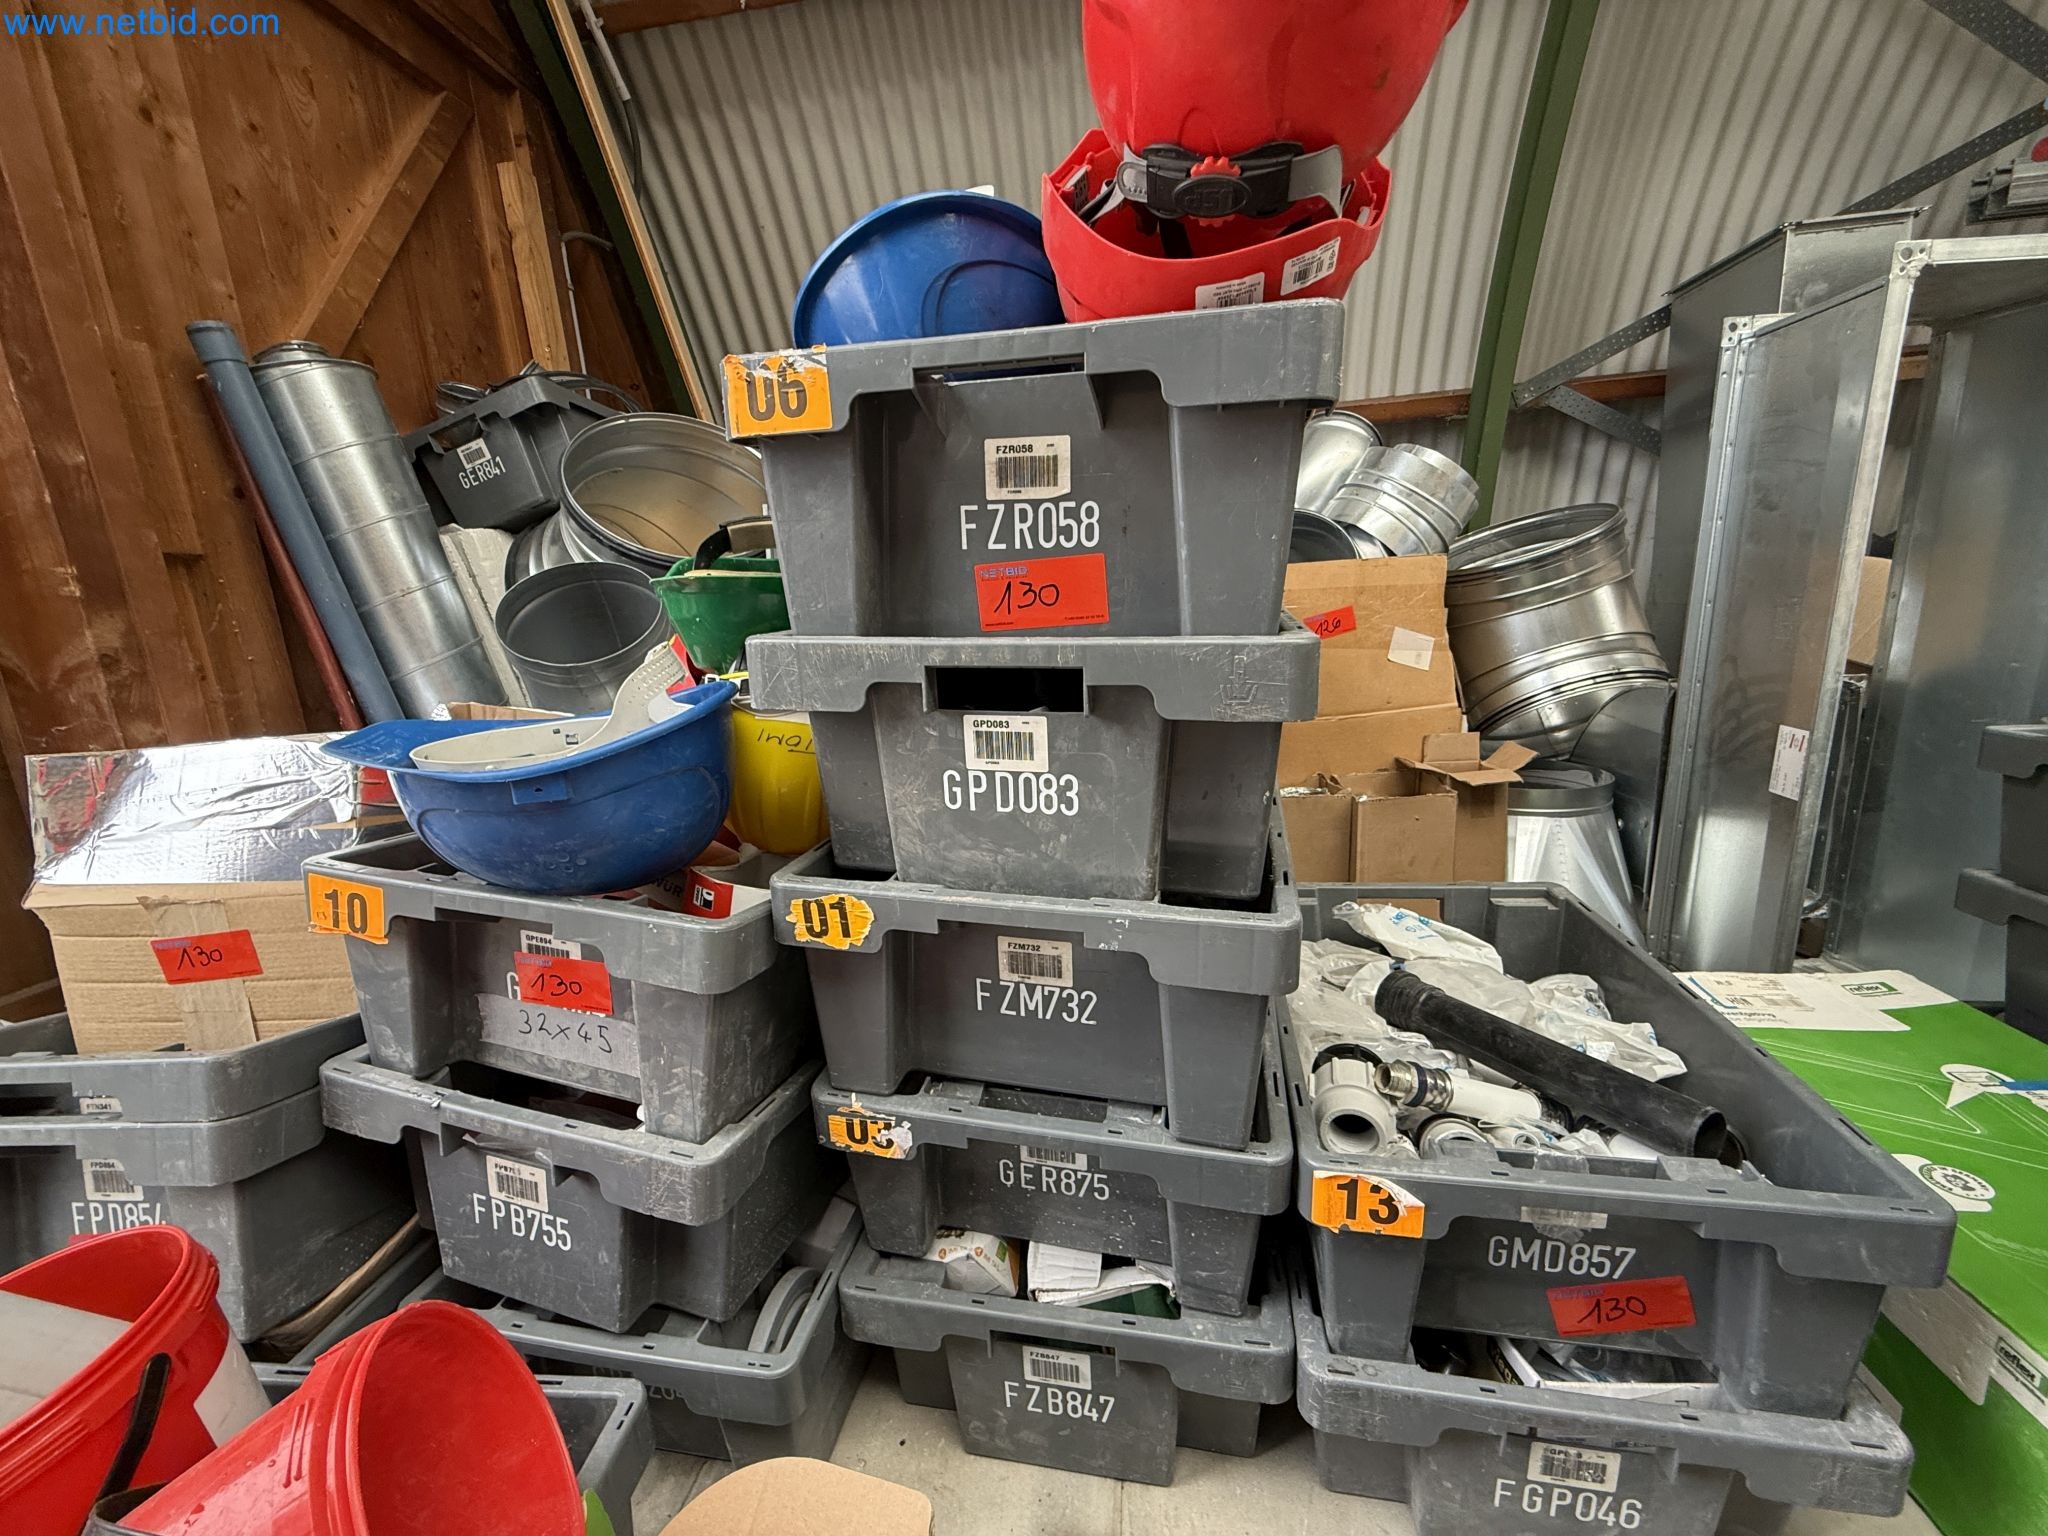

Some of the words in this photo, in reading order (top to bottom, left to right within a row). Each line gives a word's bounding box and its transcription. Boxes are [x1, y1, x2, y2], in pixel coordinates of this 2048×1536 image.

[746, 361, 807, 421] 06
[996, 444, 1033, 454] FZR058
[459, 456, 506, 488] GER841
[959, 501, 1101, 550] FZR058
[993, 581, 1060, 615] 130
[973, 720, 1010, 728] GPD083
[943, 769, 1079, 816] GPD083
[324, 888, 369, 935] 10
[802, 897, 850, 939] 01
[177, 946, 223, 970] 130
[1007, 942, 1041, 952] FZM732
[531, 973, 583, 997] 130
[976, 977, 1097, 1025] FZM732
[519, 1009, 613, 1054] 32x45
[999, 1159, 1110, 1201] GER875
[1336, 1178, 1400, 1224] 13
[473, 1192, 572, 1252] FPB755
[1488, 1235, 1637, 1280] GMD857
[1577, 1296, 1646, 1325] 130
[1030, 1351, 1060, 1360] FZB847
[1004, 1381, 1115, 1423] FZB847
[1494, 1478, 1643, 1529] FGP046
